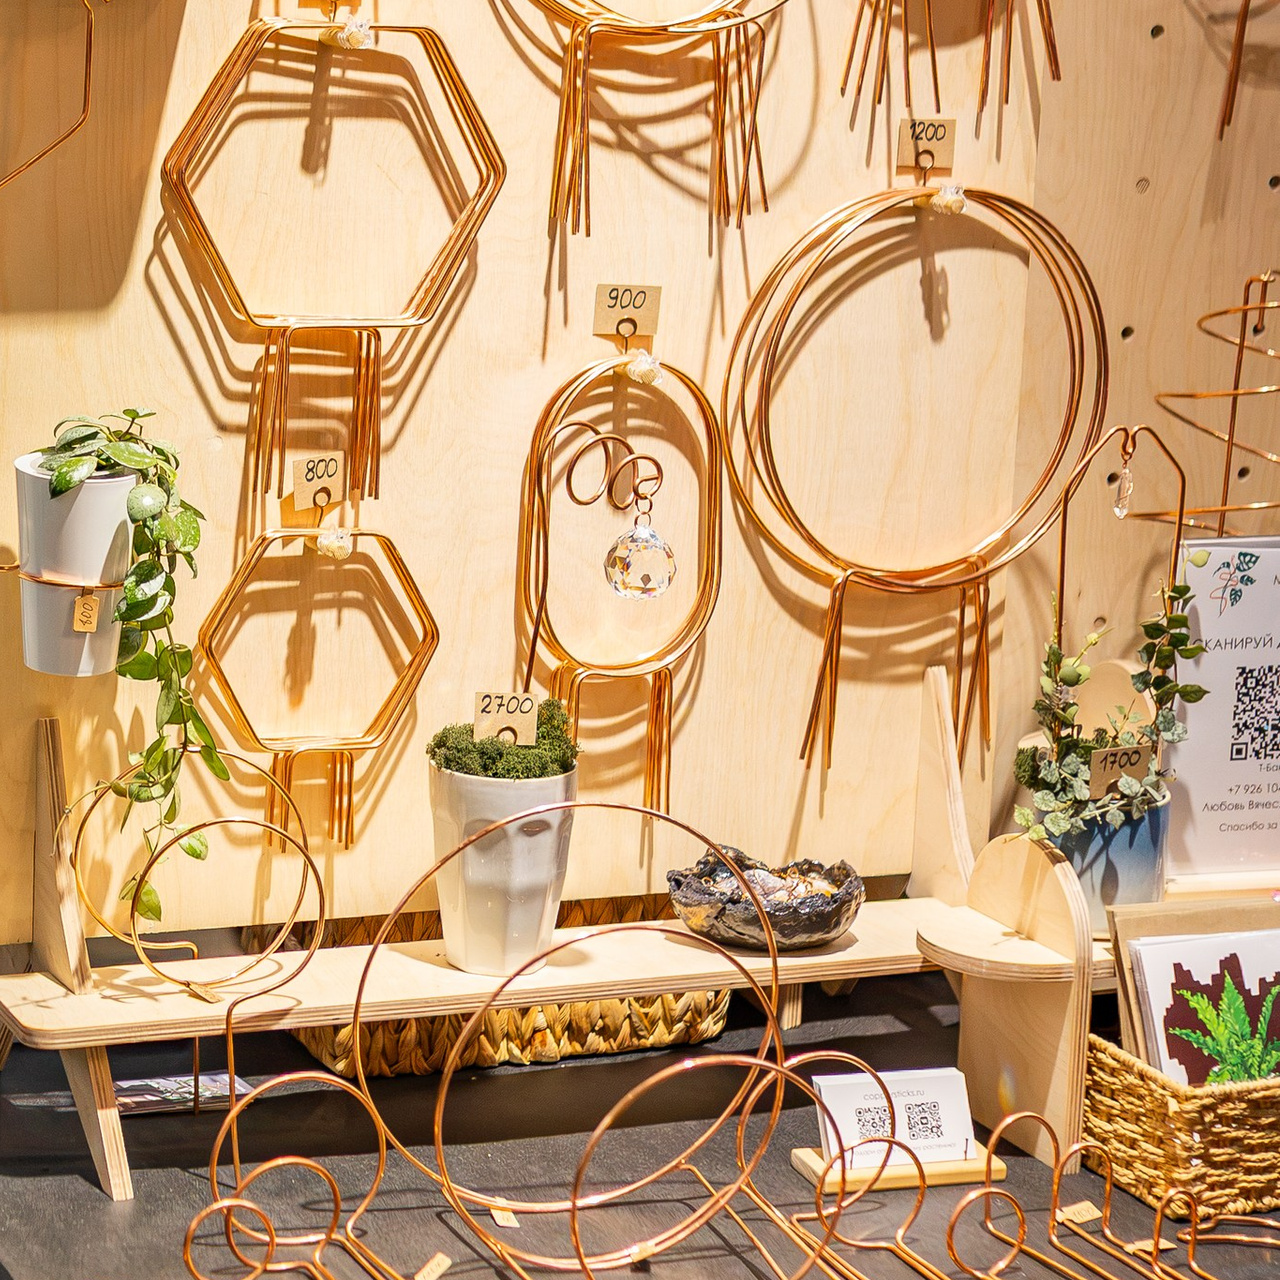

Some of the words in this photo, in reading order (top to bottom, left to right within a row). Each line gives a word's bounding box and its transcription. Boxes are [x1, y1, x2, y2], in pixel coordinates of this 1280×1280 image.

[909, 120, 946, 142] 1200
[607, 288, 647, 310] 900
[305, 458, 338, 482] 800
[480, 693, 535, 715] 2700
[1099, 749, 1142, 773] 1700
[1258, 763, 1280, 773] Т-Ба
[1228, 784, 1241, 795] +7
[1243, 783, 1263, 795] 926
[1267, 782, 1280, 793] 10
[1202, 800, 1245, 812] Любовь
[1248, 799, 1280, 810] Вячес
[1219, 821, 1264, 832] Спасибо
[1267, 821, 1278, 830] за
[863, 1088, 925, 1101] copprsticks.ru
